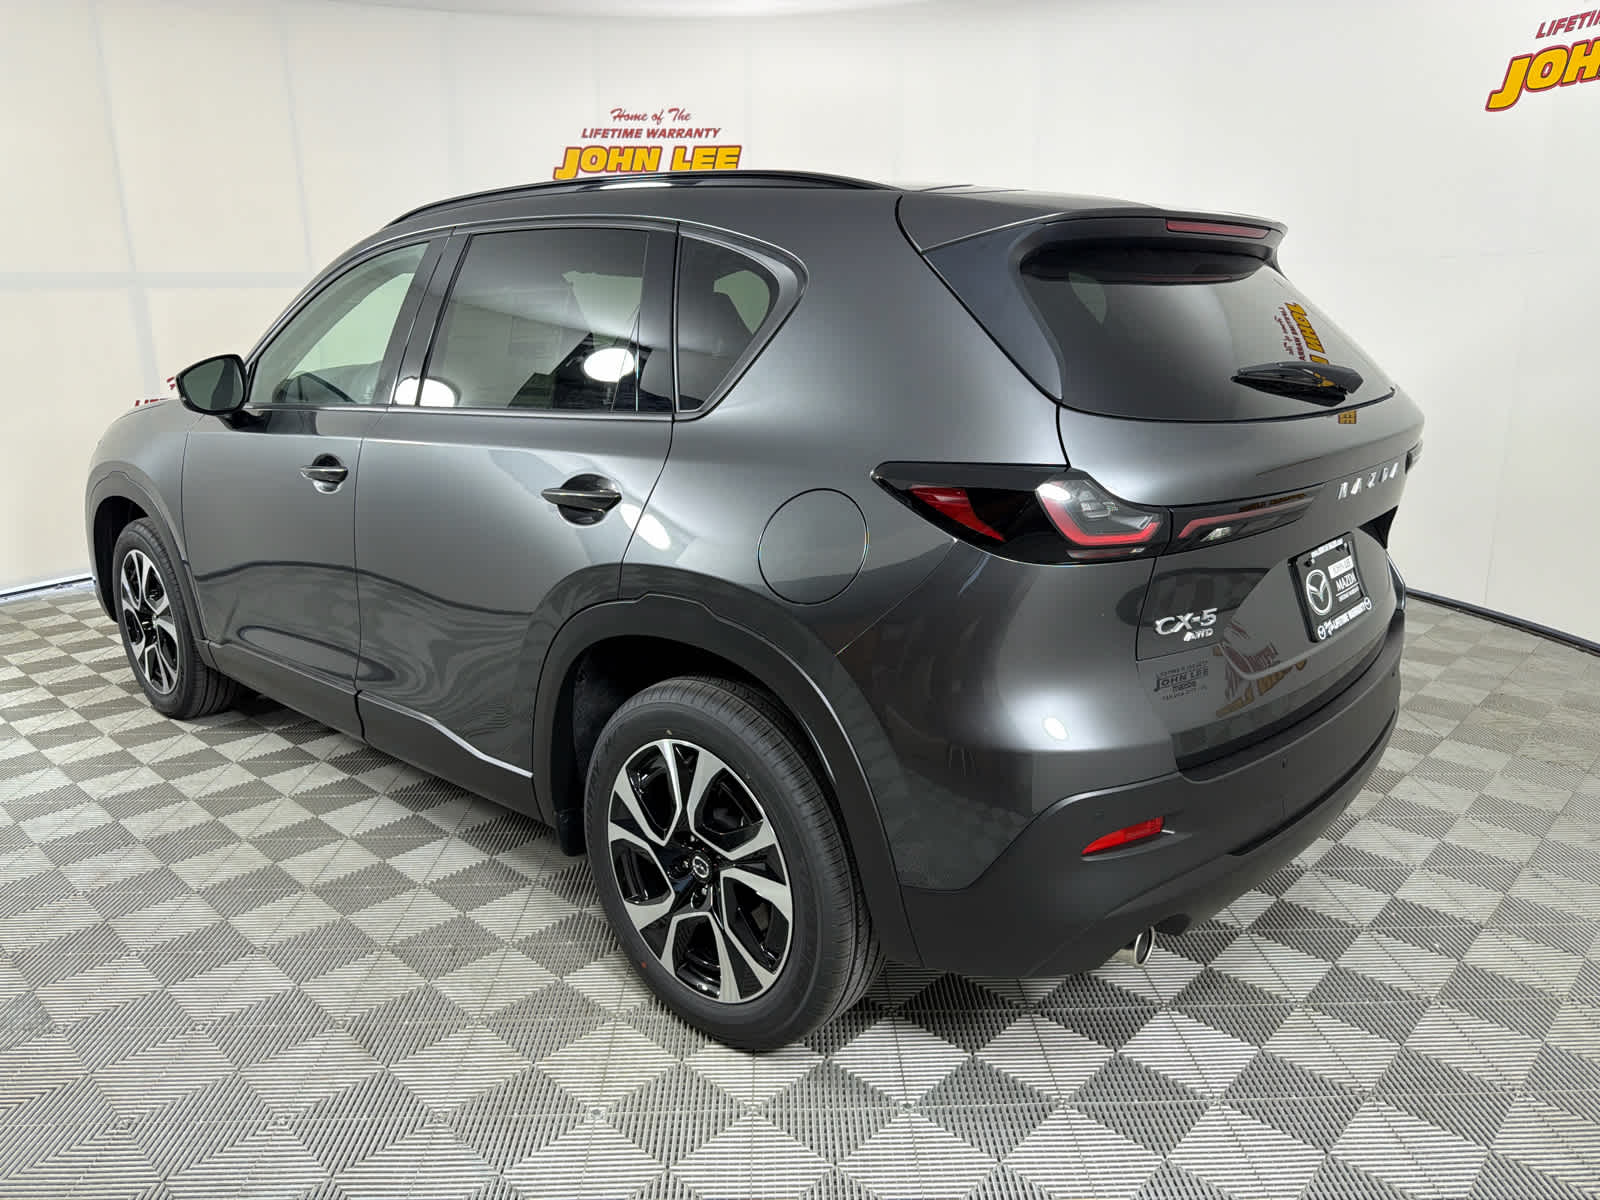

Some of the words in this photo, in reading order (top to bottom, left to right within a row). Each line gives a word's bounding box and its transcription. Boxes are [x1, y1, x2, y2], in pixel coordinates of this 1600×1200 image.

[610, 107, 648, 121] Home
[650, 109, 665, 125] of
[667, 107, 691, 121] The
[581, 128, 643, 139] LIFETIME
[646, 128, 721, 139] WARRANTY
[553, 145, 662, 180] JOHN
[670, 145, 742, 171] LEE
[1337, 462, 1399, 500] MAZDA
[1335, 571, 1357, 591] MAZDA
[1155, 608, 1218, 636] CX-5
[1183, 627, 1214, 642] AWD
[1154, 673, 1188, 692] JOHN
